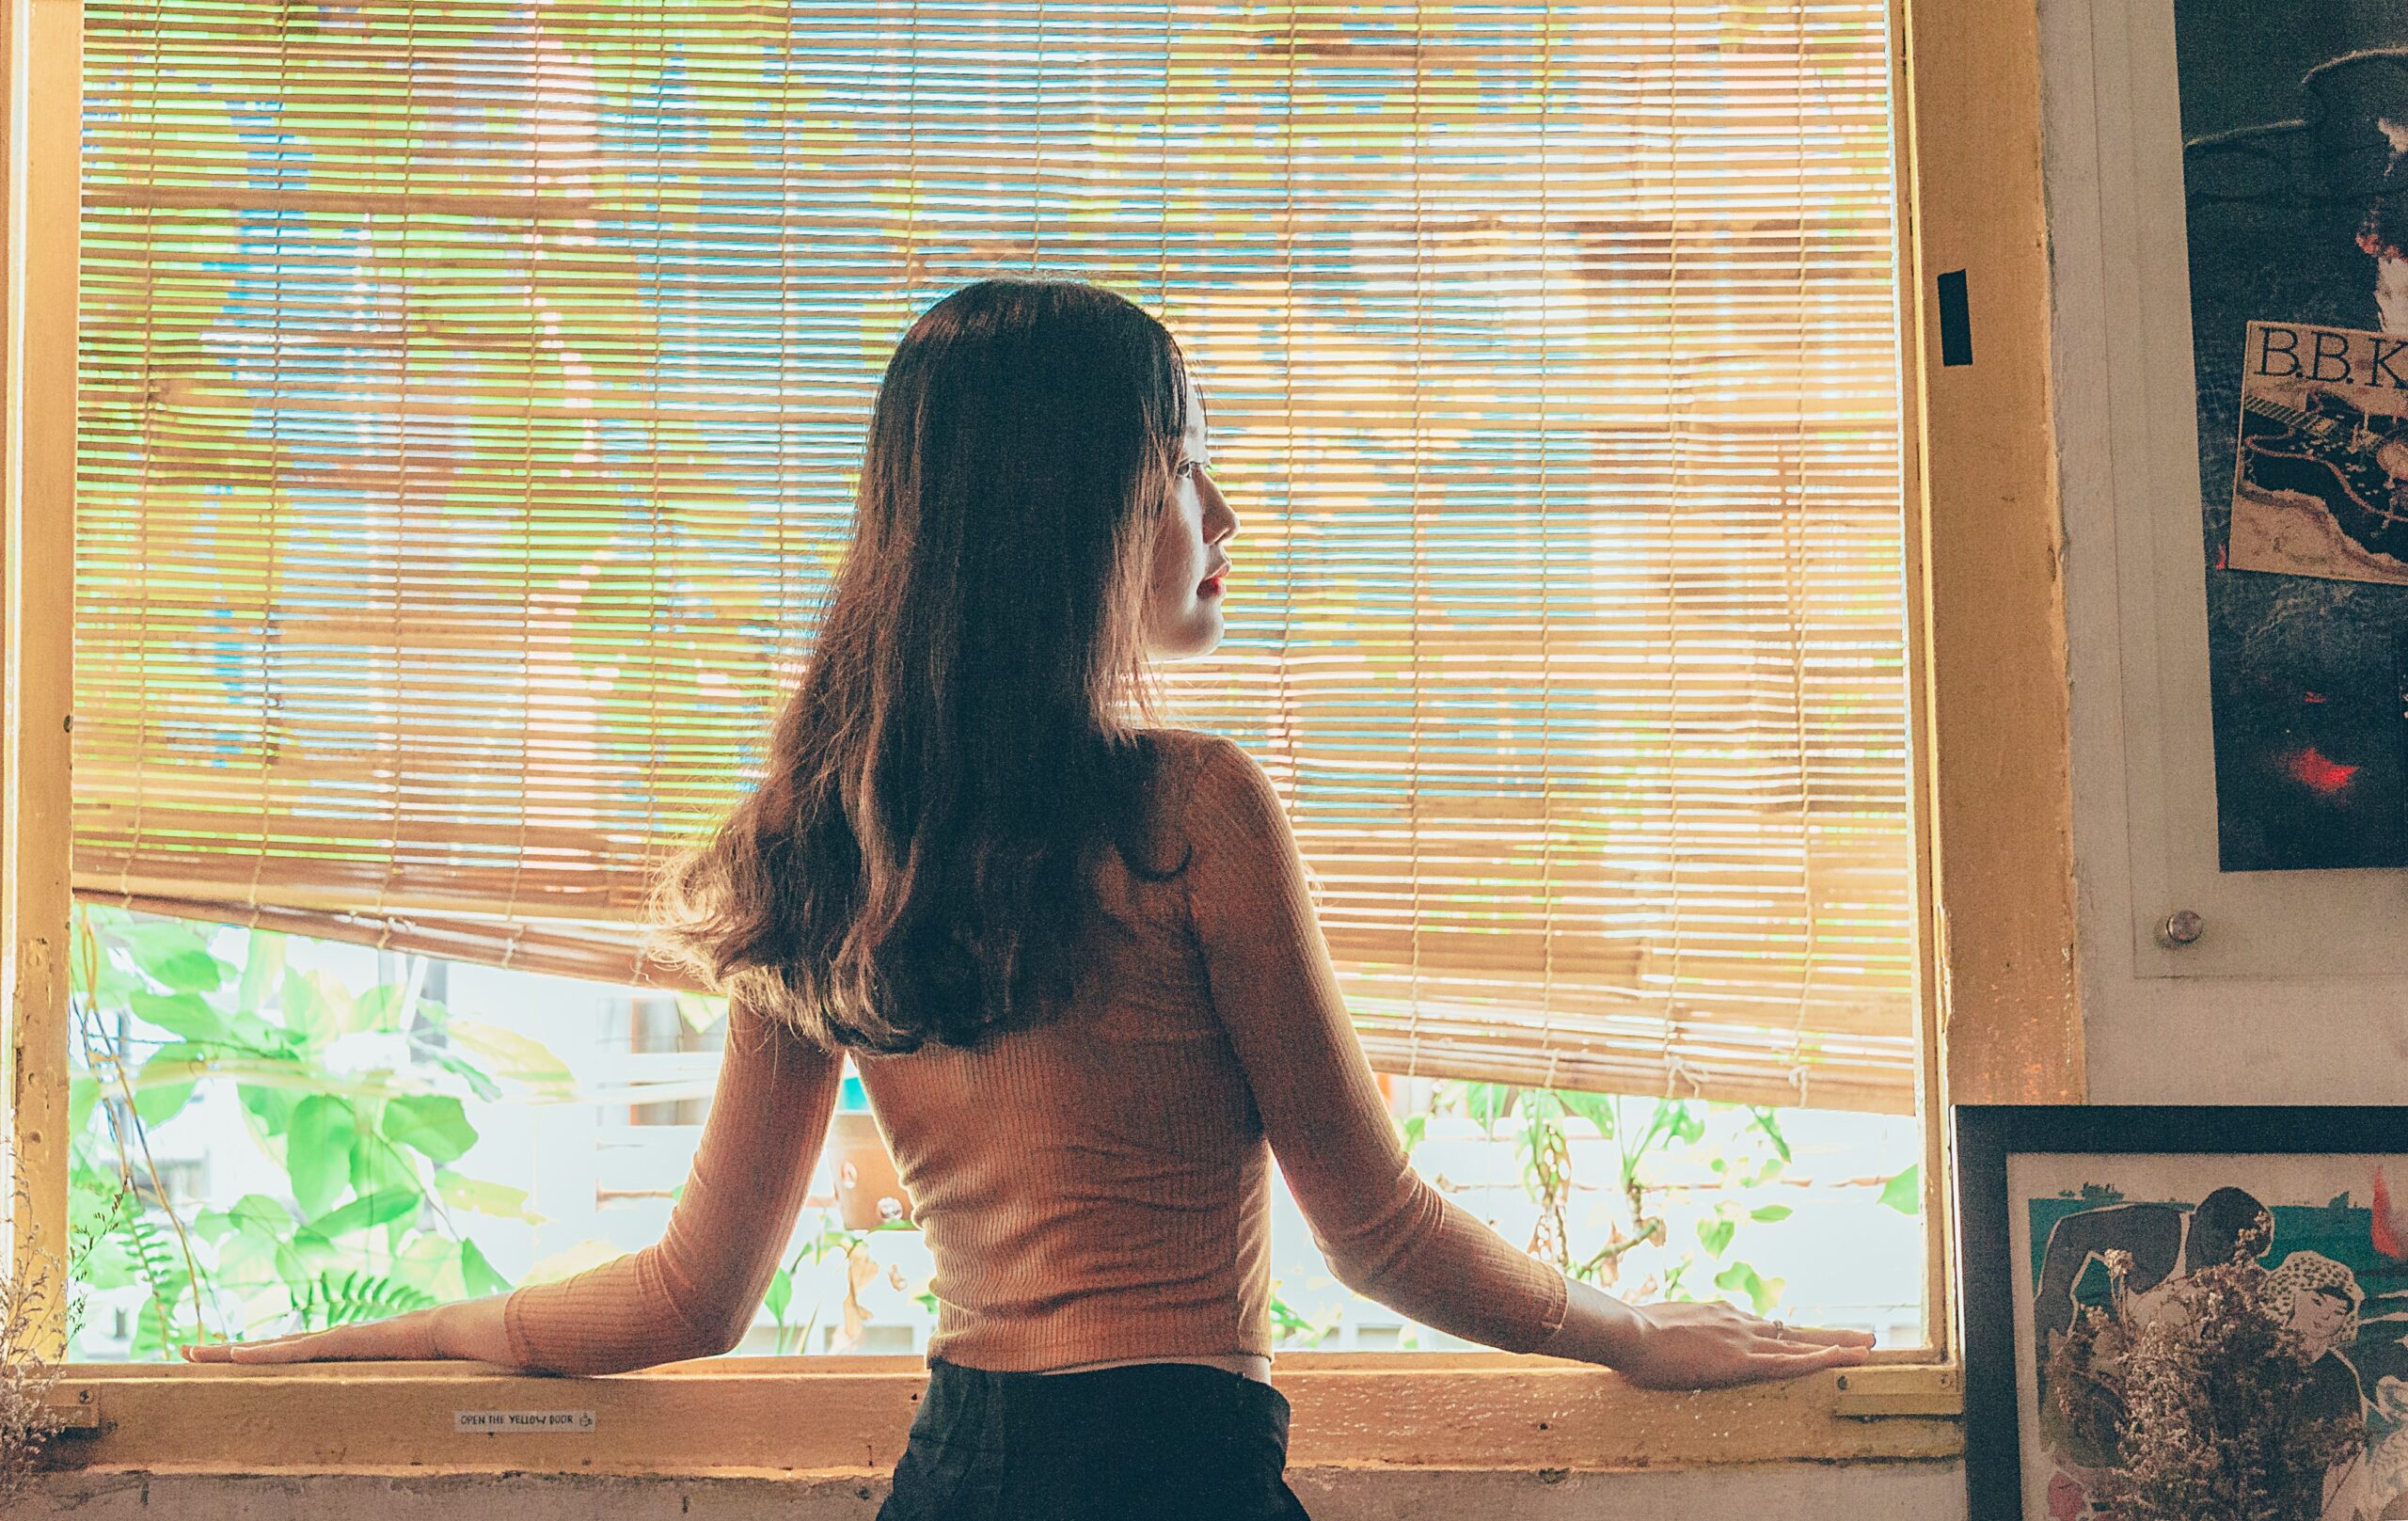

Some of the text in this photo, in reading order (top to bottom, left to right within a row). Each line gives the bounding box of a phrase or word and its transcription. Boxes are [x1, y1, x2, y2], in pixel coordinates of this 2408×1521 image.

[460, 1415, 573, 1425] OPEN THE YELLOW DOOR
